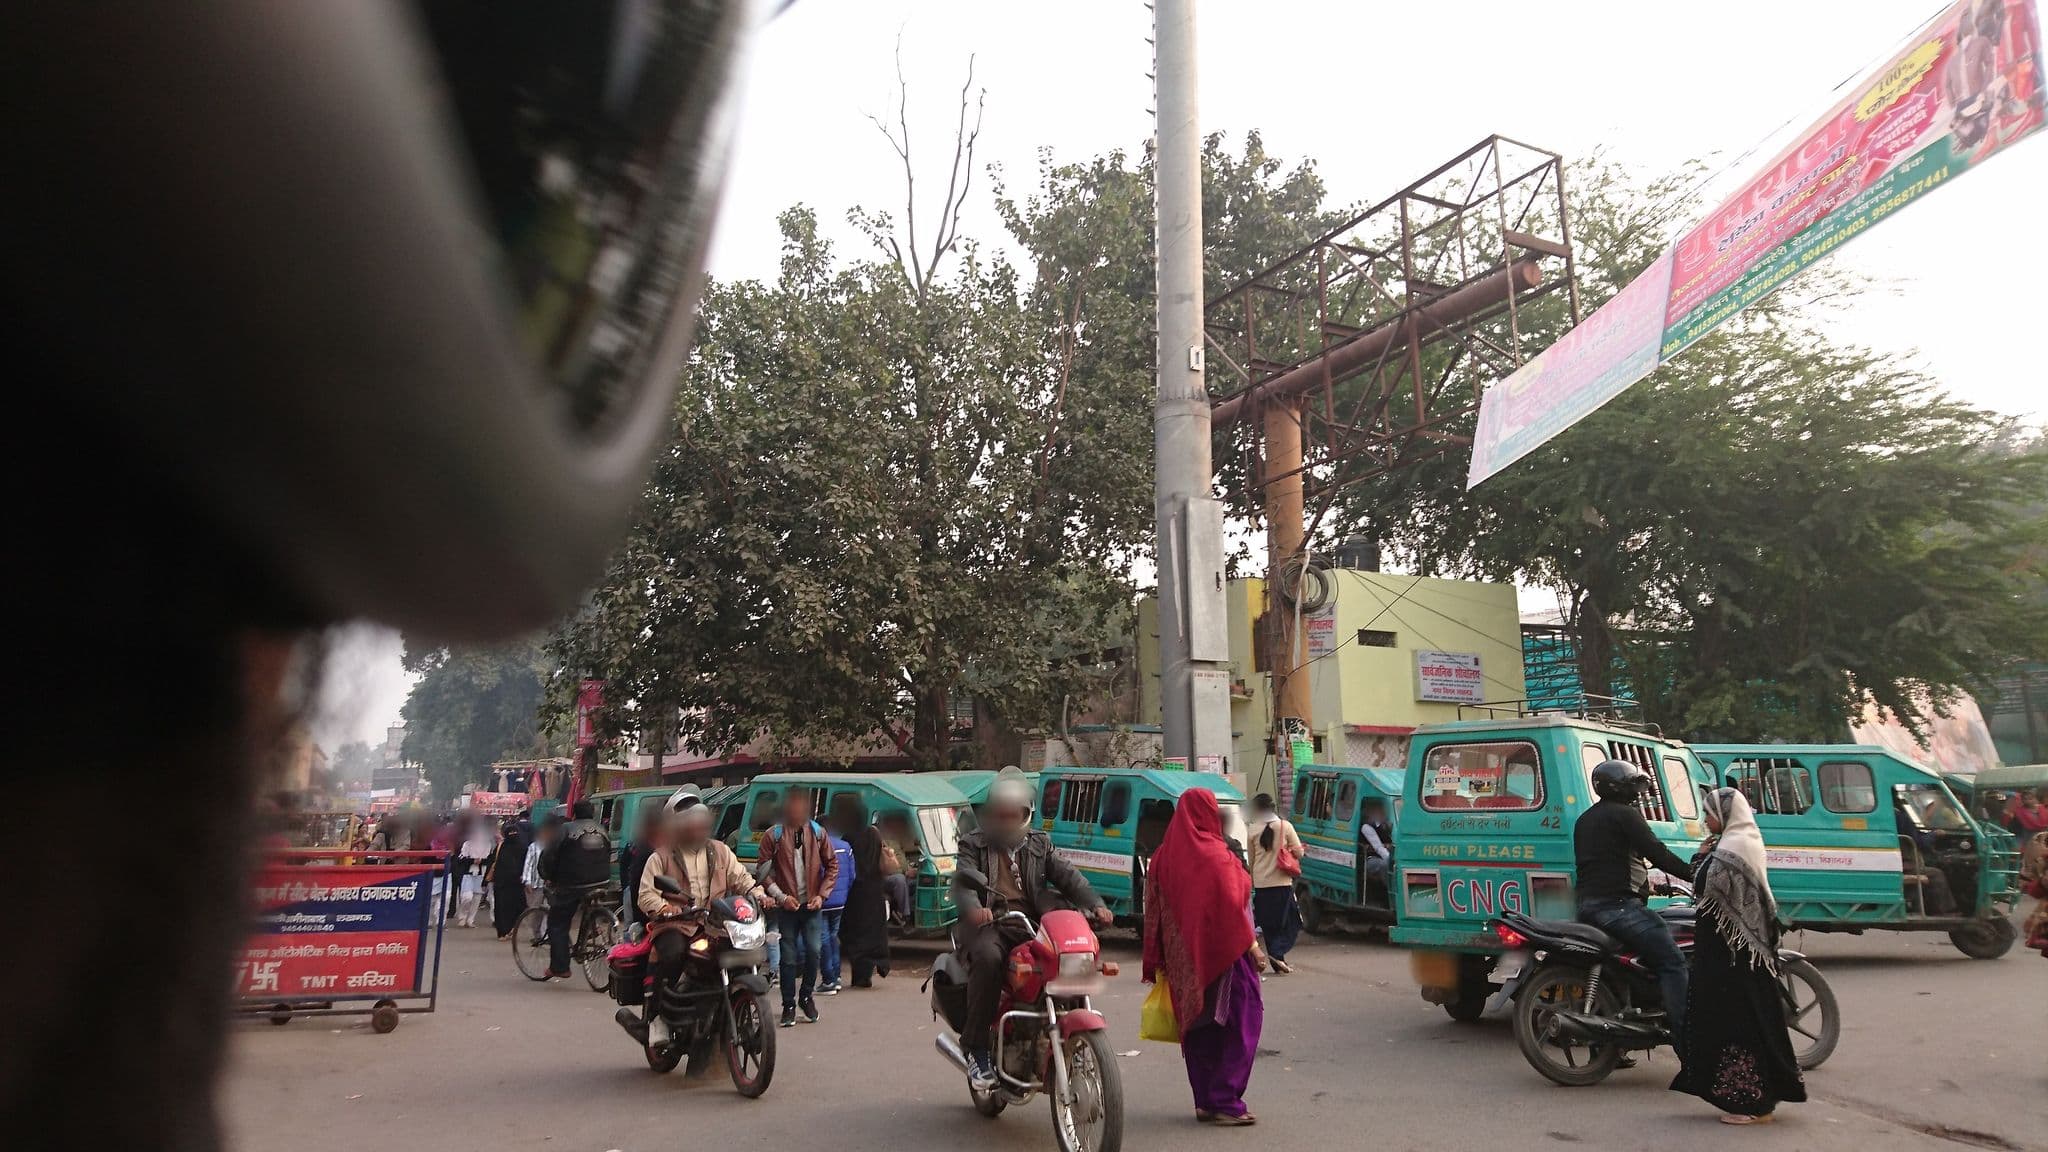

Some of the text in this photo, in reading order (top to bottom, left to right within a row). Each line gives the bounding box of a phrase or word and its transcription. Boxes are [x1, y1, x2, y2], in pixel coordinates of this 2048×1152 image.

[1880, 63, 1914, 91] 100%
[1541, 816, 1560, 829] 42
[1423, 845, 1536, 859] HORN PLEASE
[330, 886, 360, 901] अवश्य
[361, 886, 398, 901] लगाकर
[1448, 879, 1522, 915] CNG
[376, 942, 409, 955] निर्मित
[301, 971, 397, 988] TMT सरिया
